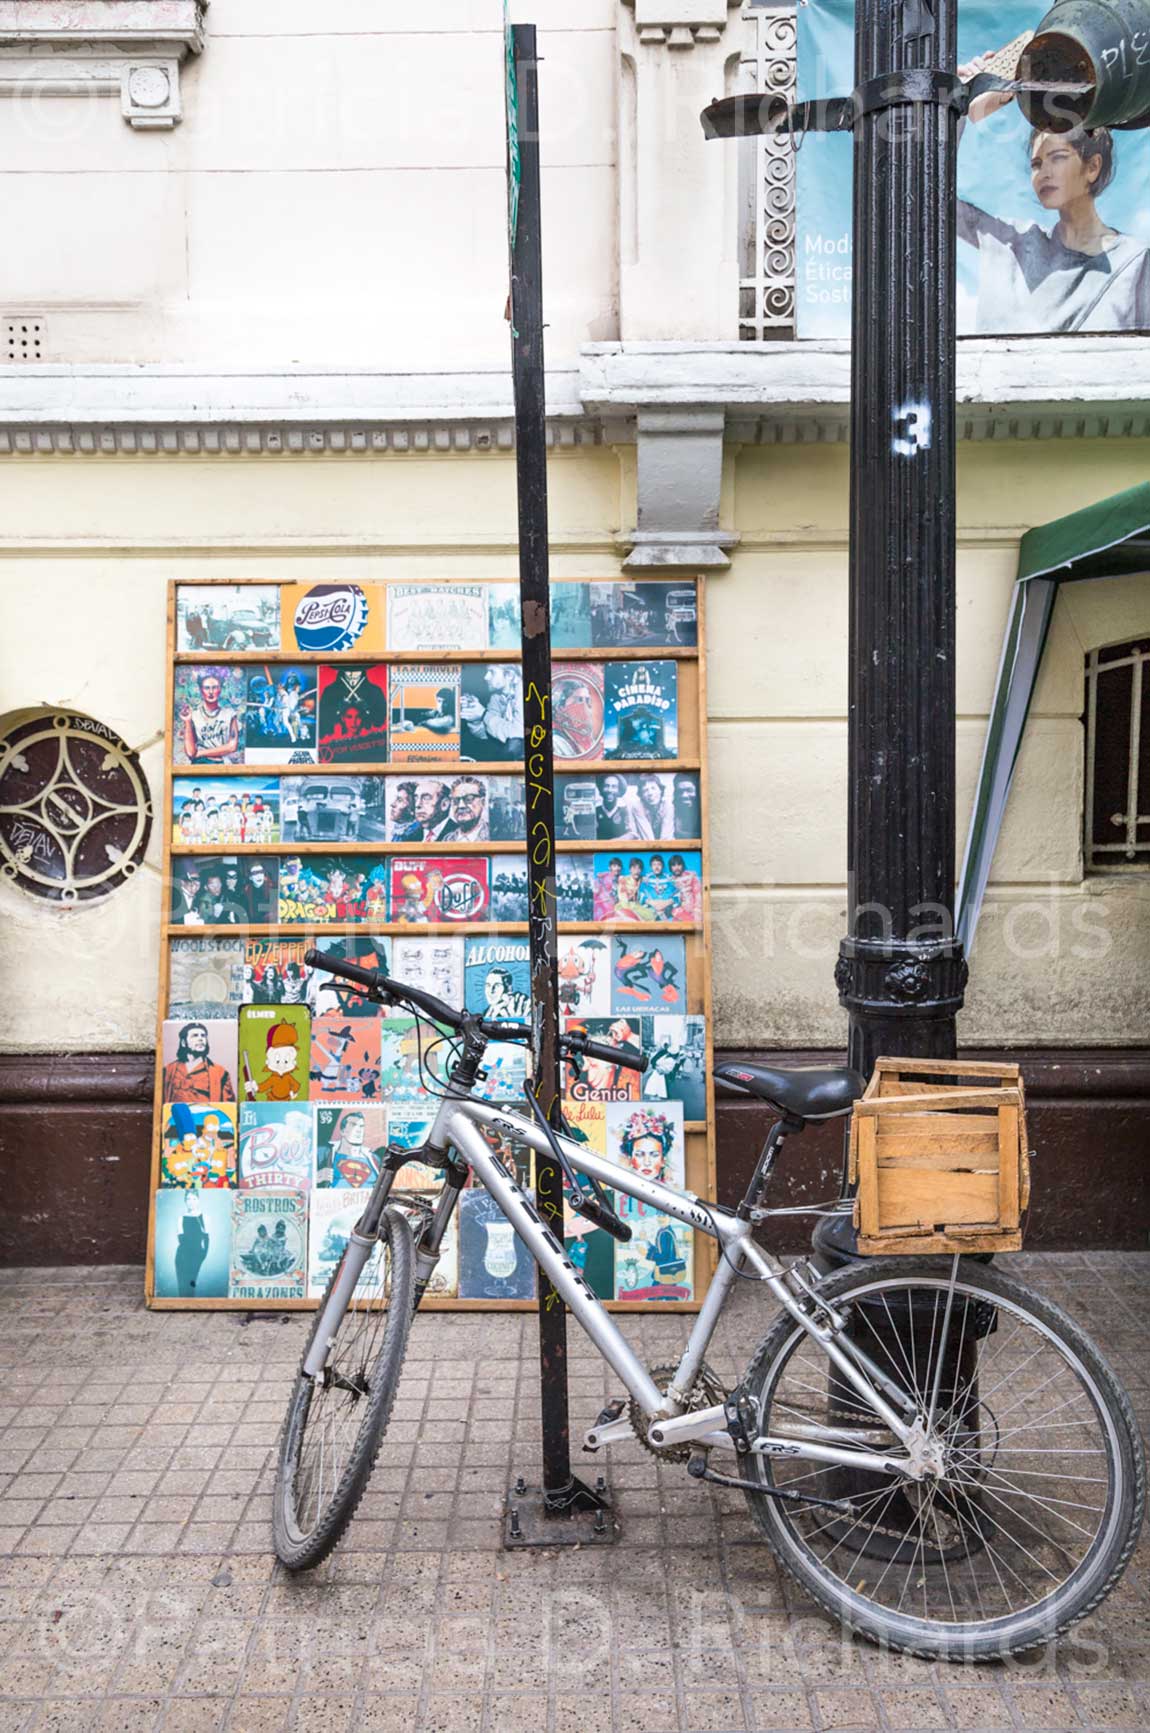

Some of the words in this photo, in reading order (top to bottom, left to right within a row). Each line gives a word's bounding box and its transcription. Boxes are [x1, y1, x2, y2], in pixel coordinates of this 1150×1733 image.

[805, 234, 852, 254] Mod
[890, 401, 931, 457] 3
[572, 1082, 632, 1101] Geniol
[245, 1172, 305, 1188] THIRTY
[244, 1198, 296, 1213] ROSTROS
[232, 1286, 304, 1298] CORAZONES
